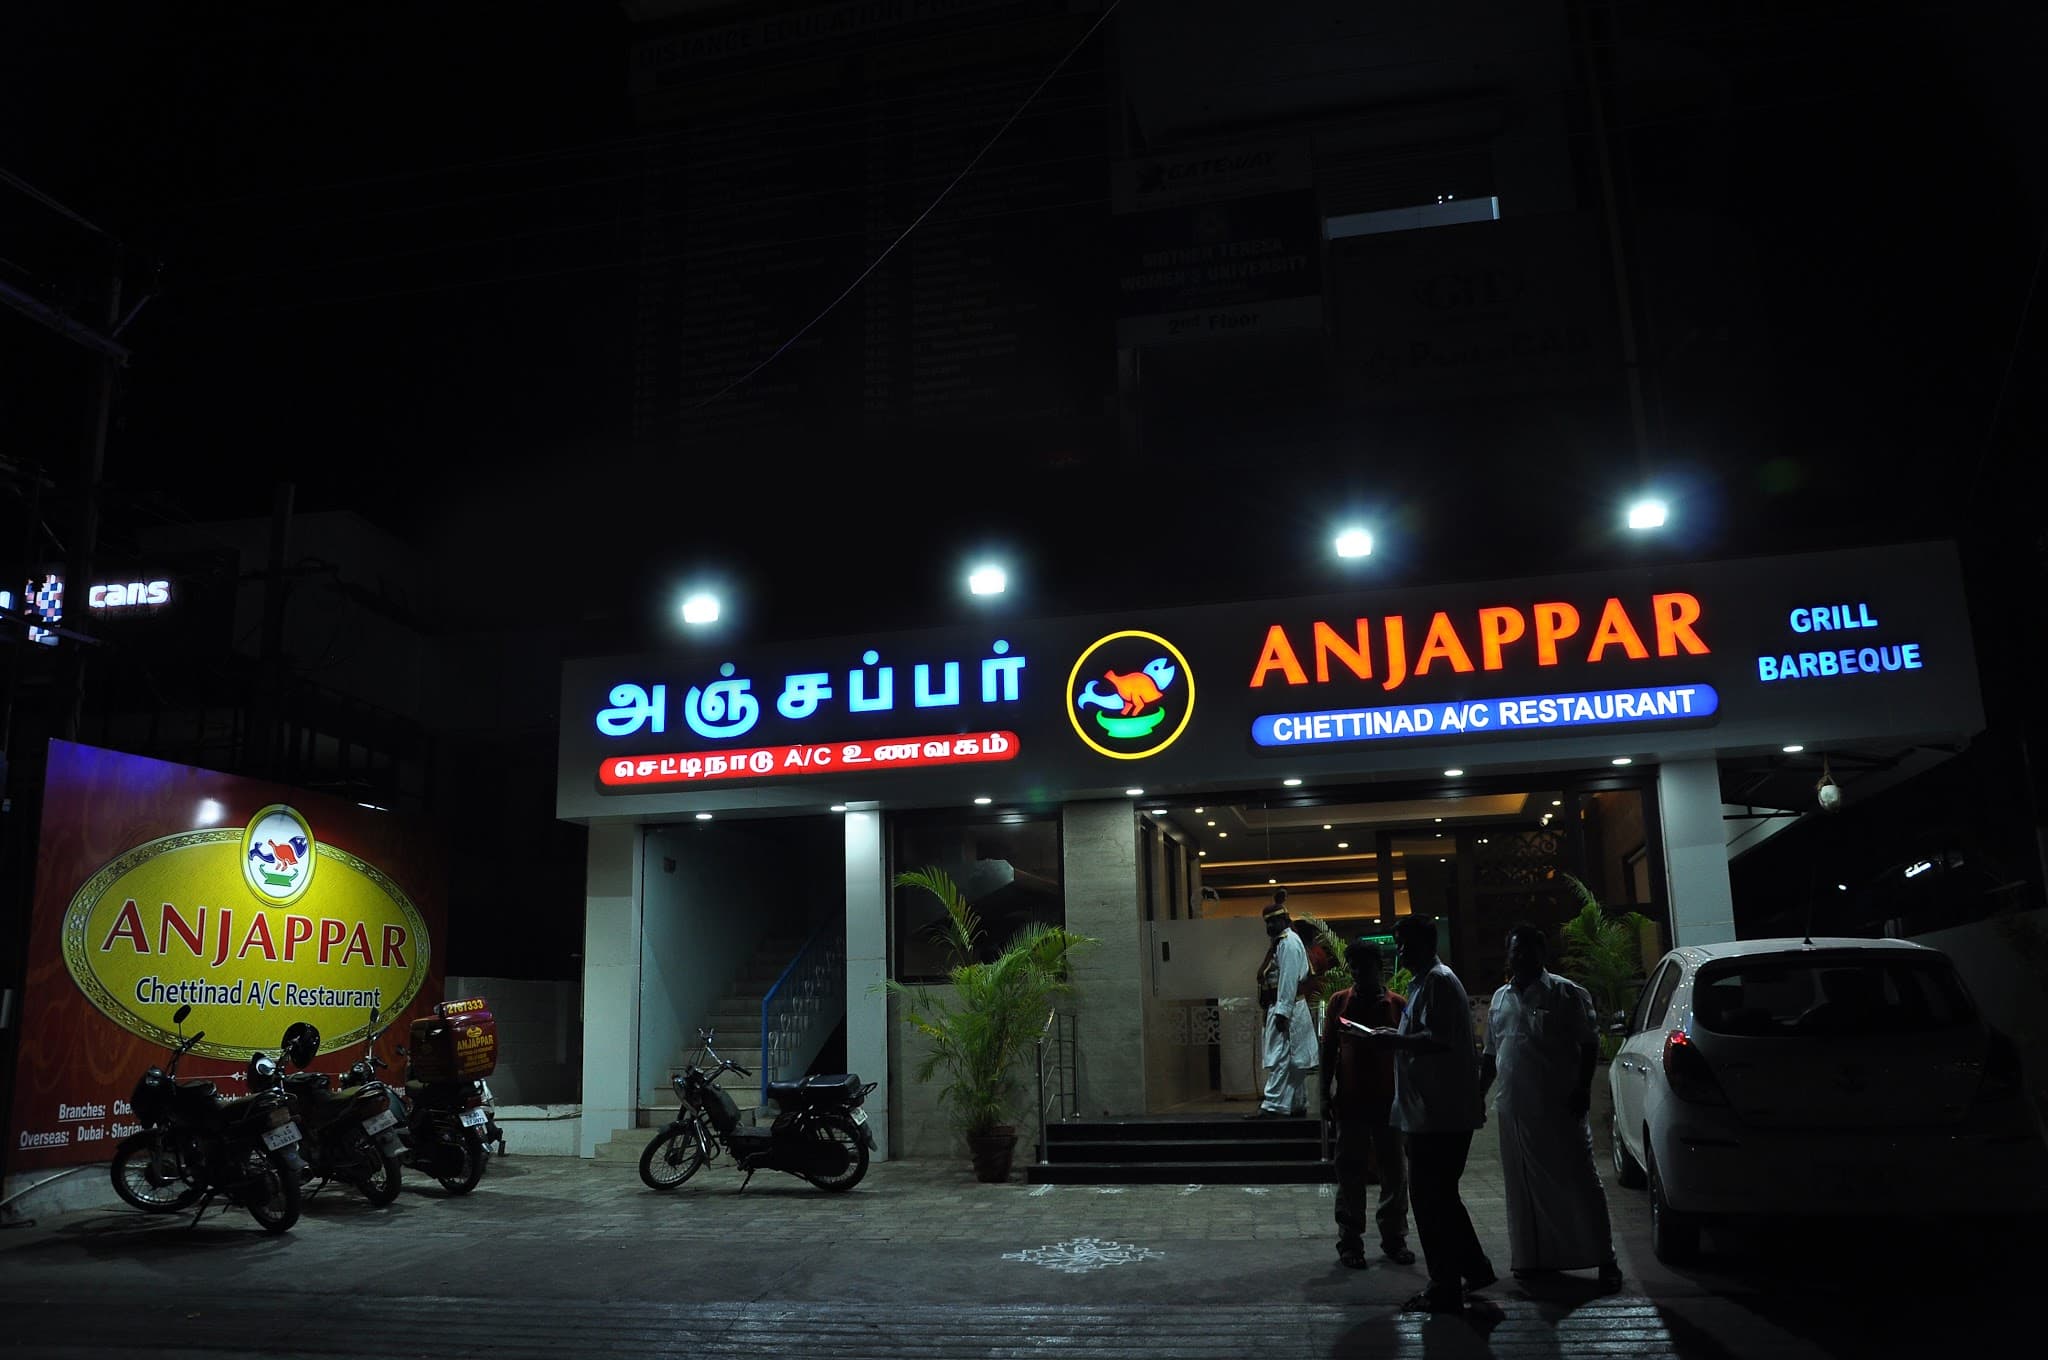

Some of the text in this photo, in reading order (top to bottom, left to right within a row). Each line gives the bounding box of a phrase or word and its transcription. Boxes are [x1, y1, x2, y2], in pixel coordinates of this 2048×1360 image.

[1790, 603, 1878, 633] GRILL
[1249, 592, 1711, 691] ANJAPPAR
[1758, 643, 1923, 682] BARBEQUE
[594, 639, 1027, 739] அஞ்சப்பர்
[1273, 689, 1696, 742] CHETTINAD A/C RESTAURANT
[614, 733, 1009, 778] செட்டிநாடு A/C உணவகம்
[101, 898, 409, 968] ANJAPPAR
[135, 975, 381, 1010] Chettinad A/C Restaurant
[457, 1033, 494, 1050] ANJAPPAR
[58, 1101, 106, 1120] Branches:
[20, 1129, 70, 1148] Overseas:
[77, 1123, 104, 1142] Dubai
